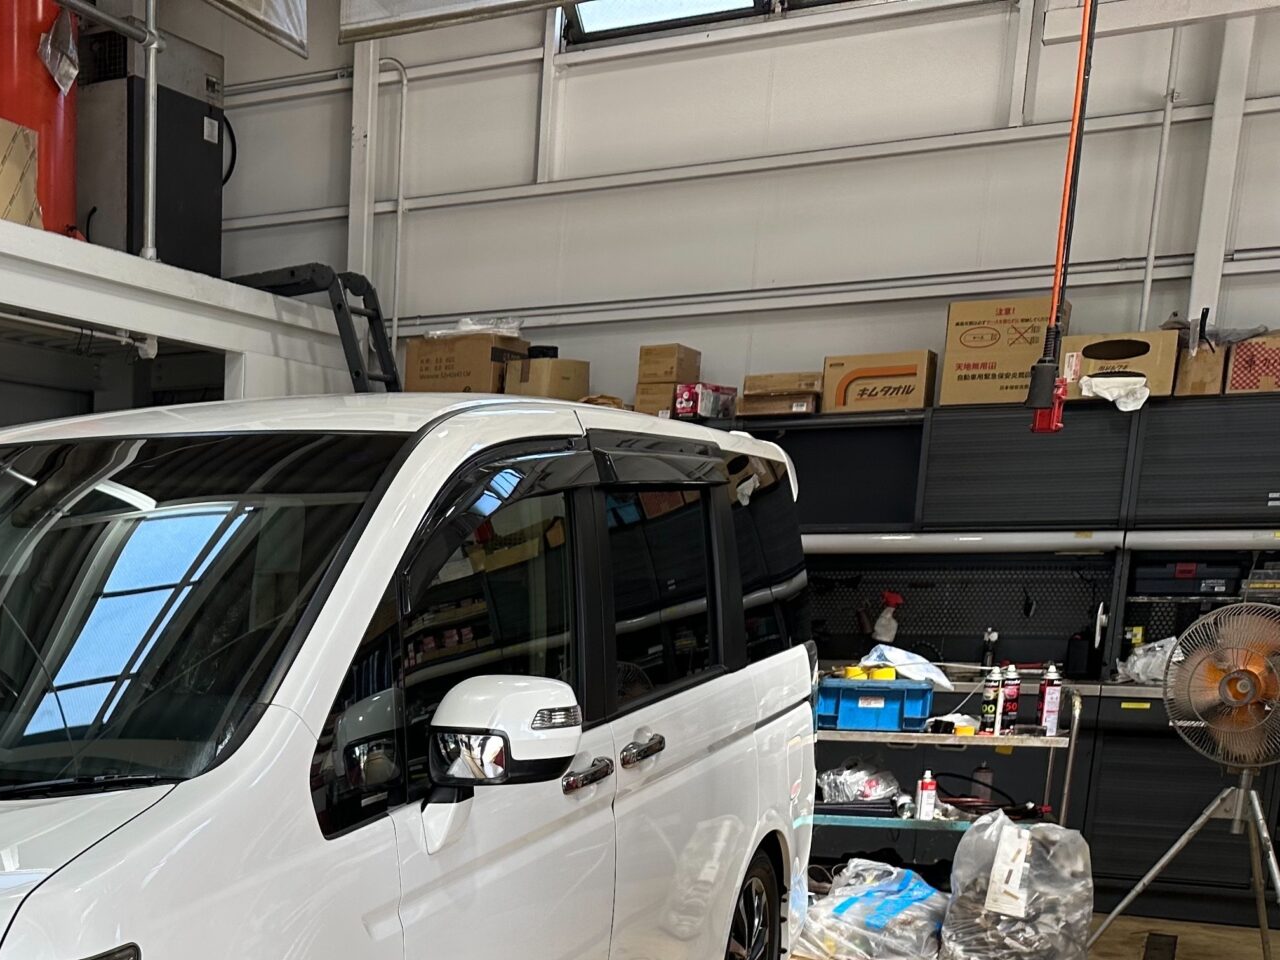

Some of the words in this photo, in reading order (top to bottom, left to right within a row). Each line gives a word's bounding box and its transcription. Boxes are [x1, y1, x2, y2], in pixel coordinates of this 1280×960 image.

[857, 384, 916, 398] キムタオル
